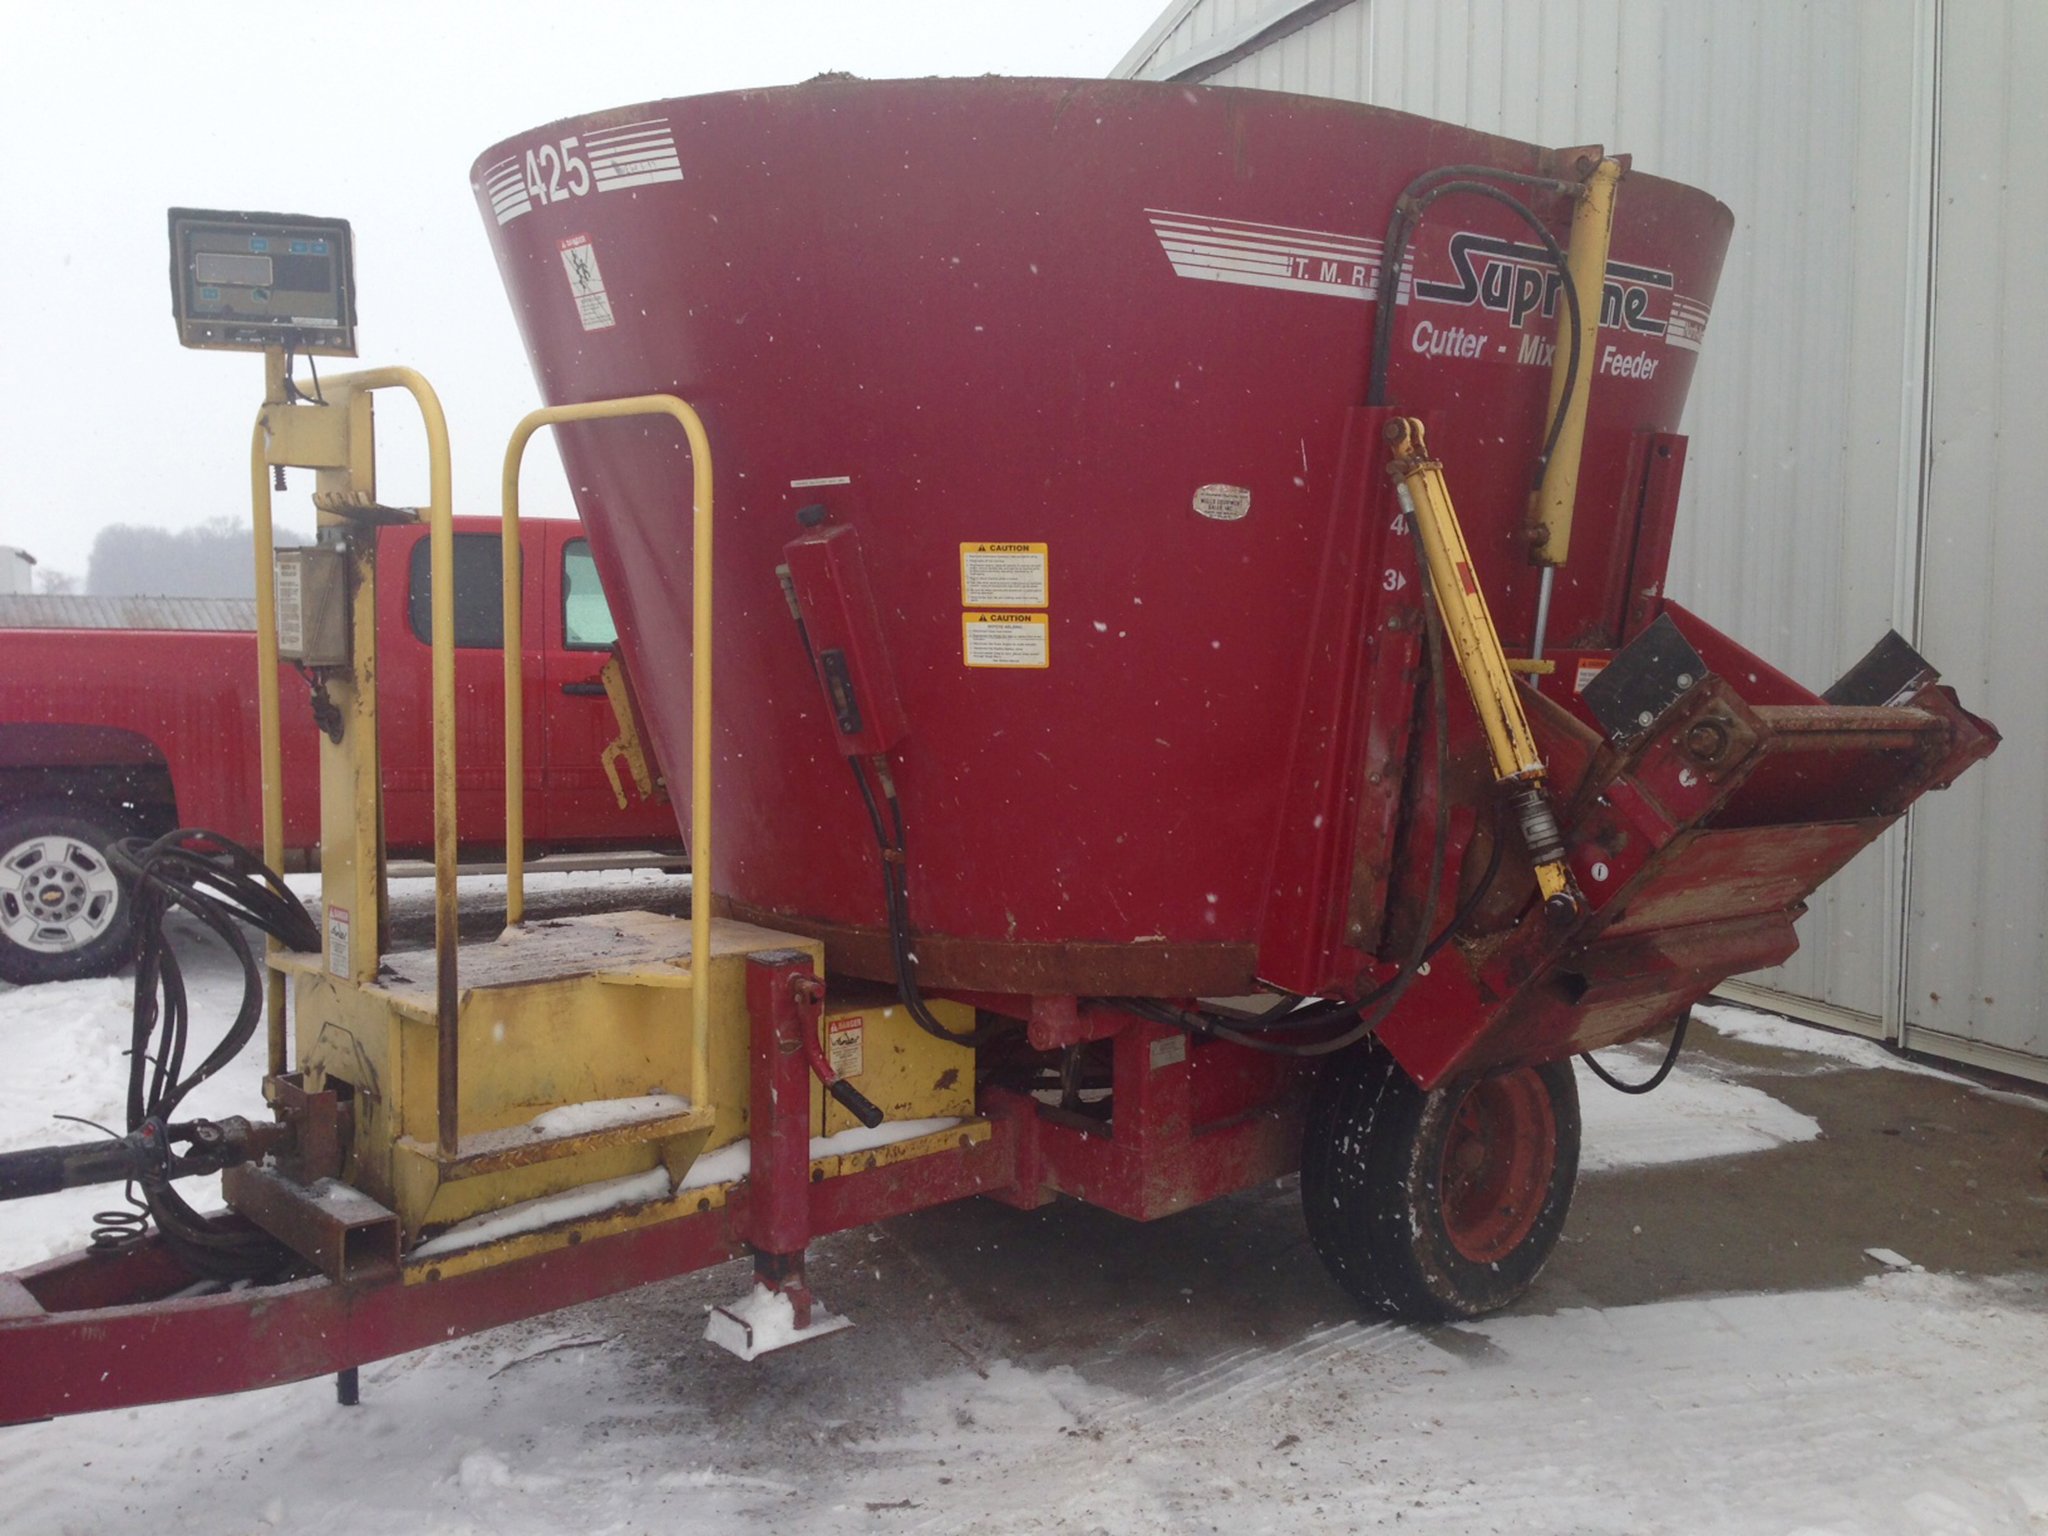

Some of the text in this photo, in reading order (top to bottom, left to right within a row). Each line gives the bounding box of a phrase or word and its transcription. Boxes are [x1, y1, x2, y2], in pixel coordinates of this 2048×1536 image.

[526, 137, 590, 205] 425
[1414, 231, 1673, 336] Suprme
[1412, 320, 1488, 358] Cutter
[1600, 345, 1659, 380] Feeder
[1390, 514, 1404, 535] 4
[1383, 569, 1397, 591] 3
[990, 614, 1032, 622] CAUTION
